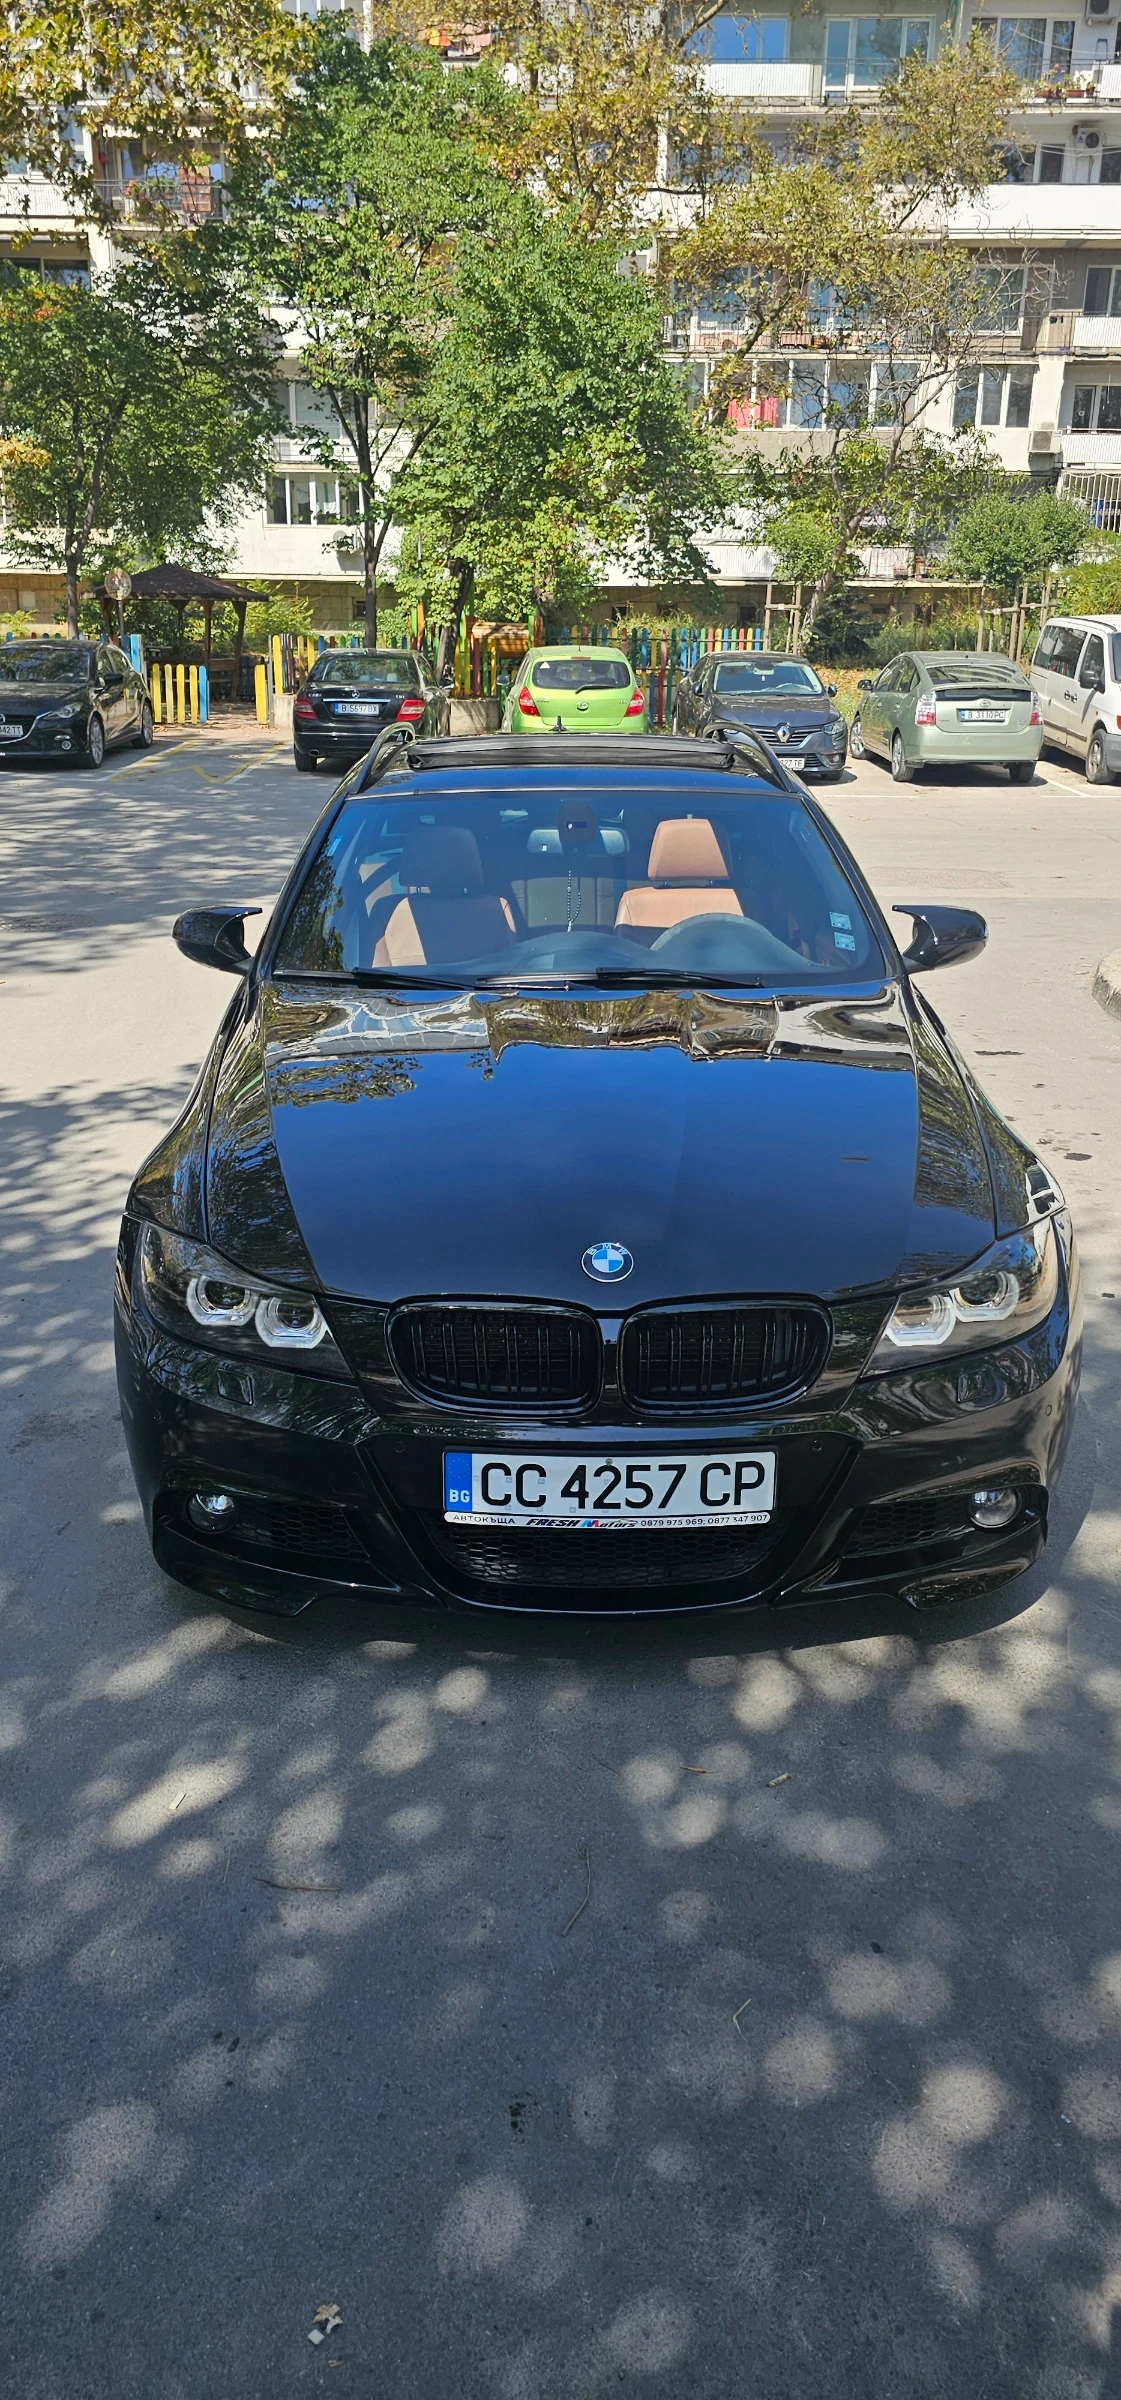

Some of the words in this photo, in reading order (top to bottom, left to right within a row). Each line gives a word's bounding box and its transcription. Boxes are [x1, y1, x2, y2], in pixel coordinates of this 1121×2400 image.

[341, 704, 347, 713] B
[967, 711, 973, 719] B
[975, 711, 993, 719] 3110
[586, 1243, 629, 1256] BMW
[481, 1462, 547, 1508] CC
[560, 1463, 687, 1509] 4257
[700, 1460, 766, 1507] CP
[449, 1488, 471, 1504] BG
[453, 1514, 516, 1525] АВТОКЪЩА
[525, 1518, 581, 1528] FRESH
[581, 1518, 638, 1529] Motors
[640, 1519, 664, 1527] 0879
[666, 1518, 683, 1526] 975
[685, 1518, 706, 1526] 969;
[707, 1516, 730, 1525] 0877
[732, 1515, 749, 1523] 347
[750, 1514, 768, 1522] 907
